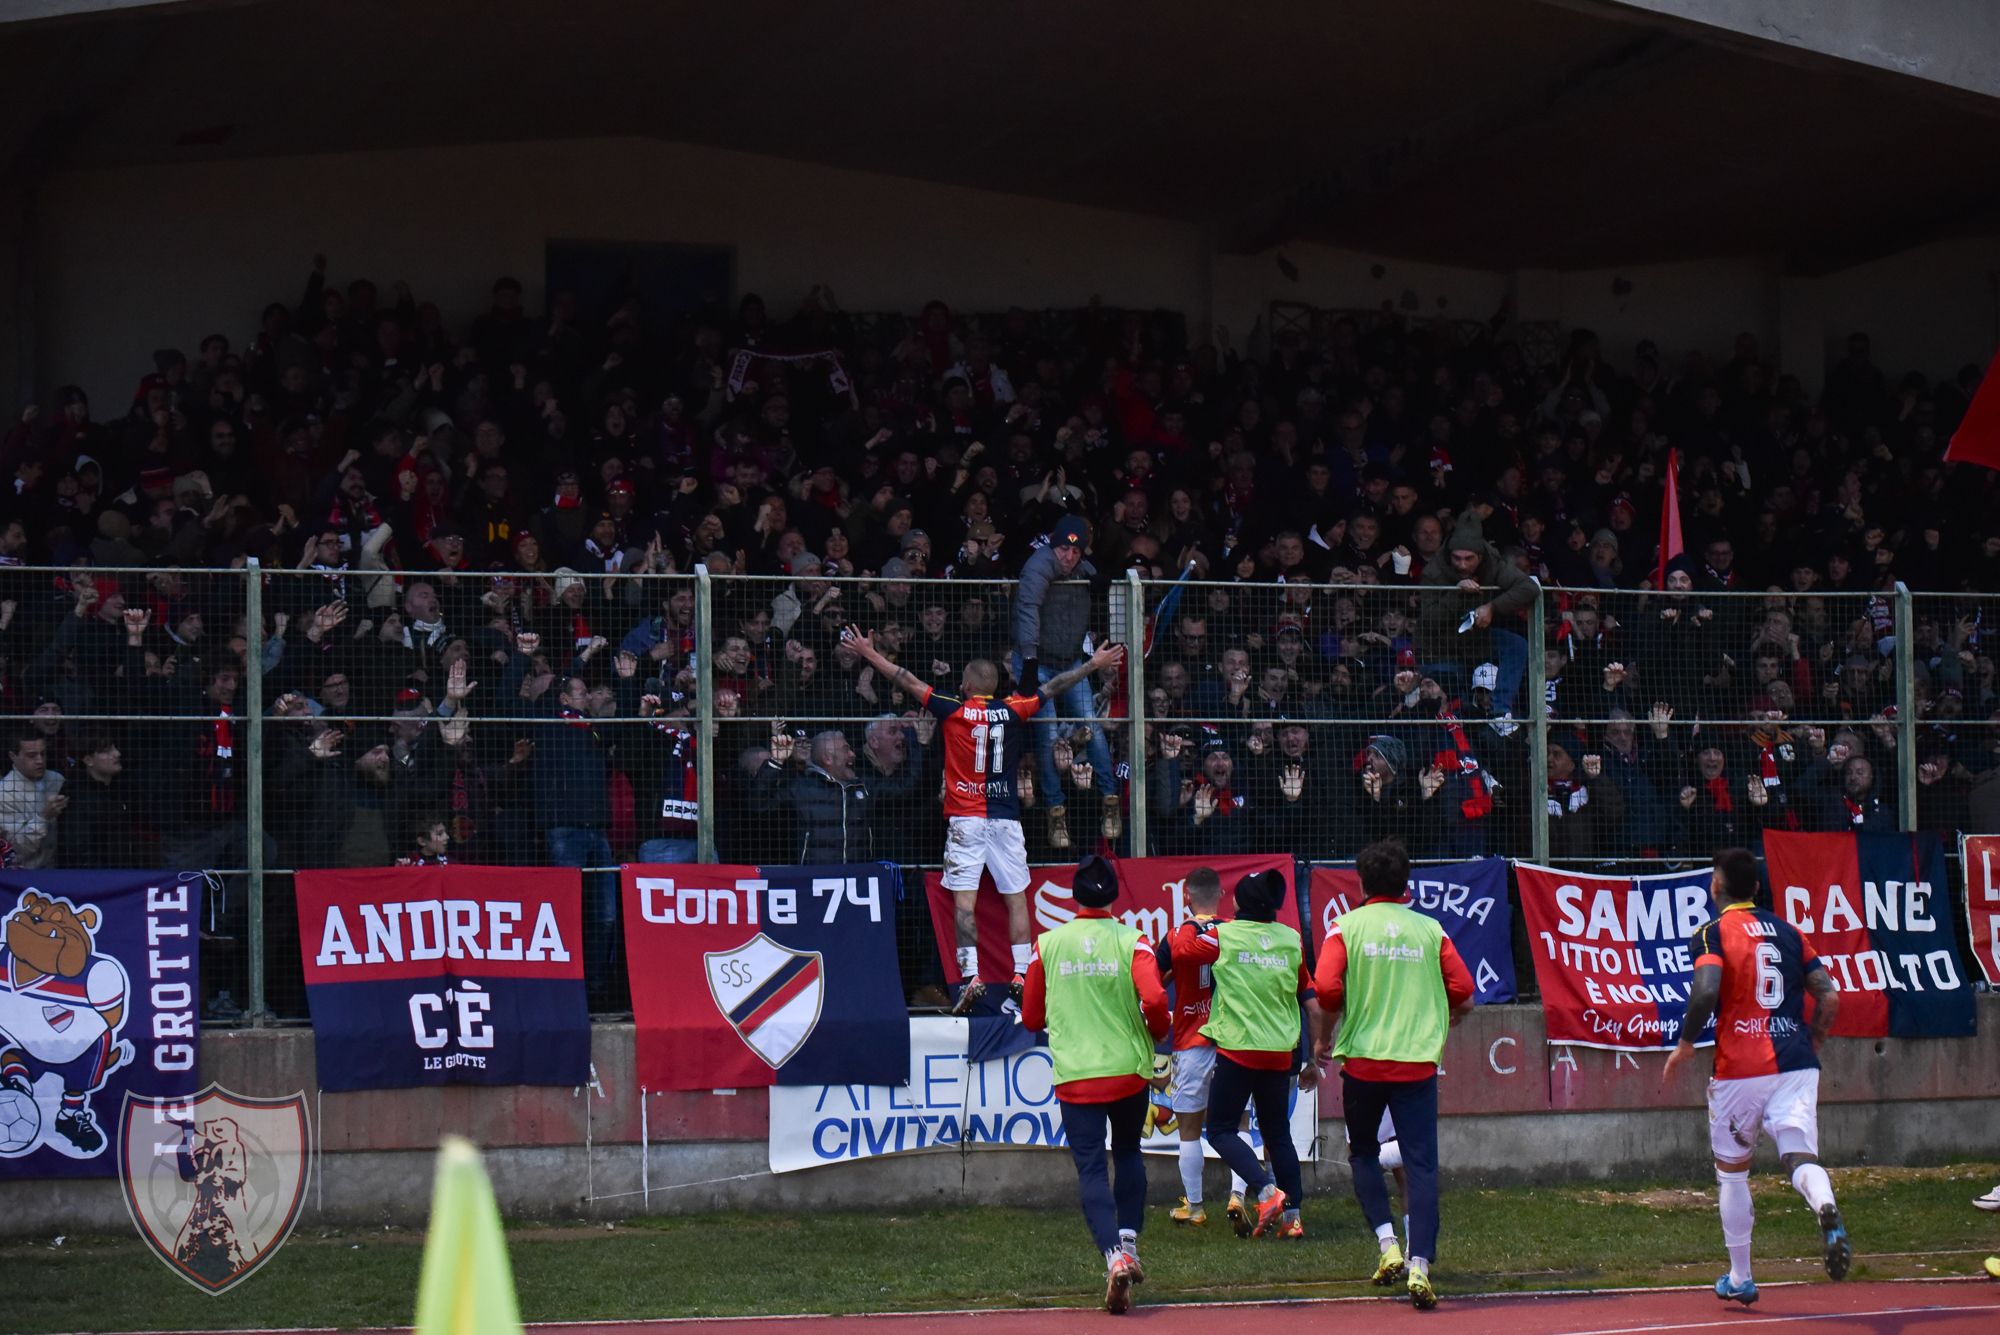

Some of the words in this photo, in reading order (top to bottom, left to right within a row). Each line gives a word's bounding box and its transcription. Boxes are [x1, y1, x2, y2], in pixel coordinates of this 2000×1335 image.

[963, 706, 1010, 722] BATTISTA
[970, 723, 1005, 773] 11
[812, 876, 882, 924] 74
[1555, 885, 1711, 941] SAMB
[1785, 880, 1936, 933] CANE
[316, 899, 570, 966] ANDREA
[147, 886, 195, 1072] GROTTE
[721, 959, 752, 988] SSS
[1626, 948, 1654, 975] IL
[1755, 942, 1784, 1009] 6
[1819, 950, 1960, 992] CIOLTO
[1606, 983, 1685, 1004] NOIA
[1627, 1014, 1679, 1039] Group
[424, 1057, 443, 1070] LE
[812, 1112, 1070, 1159] CIVITANOV
